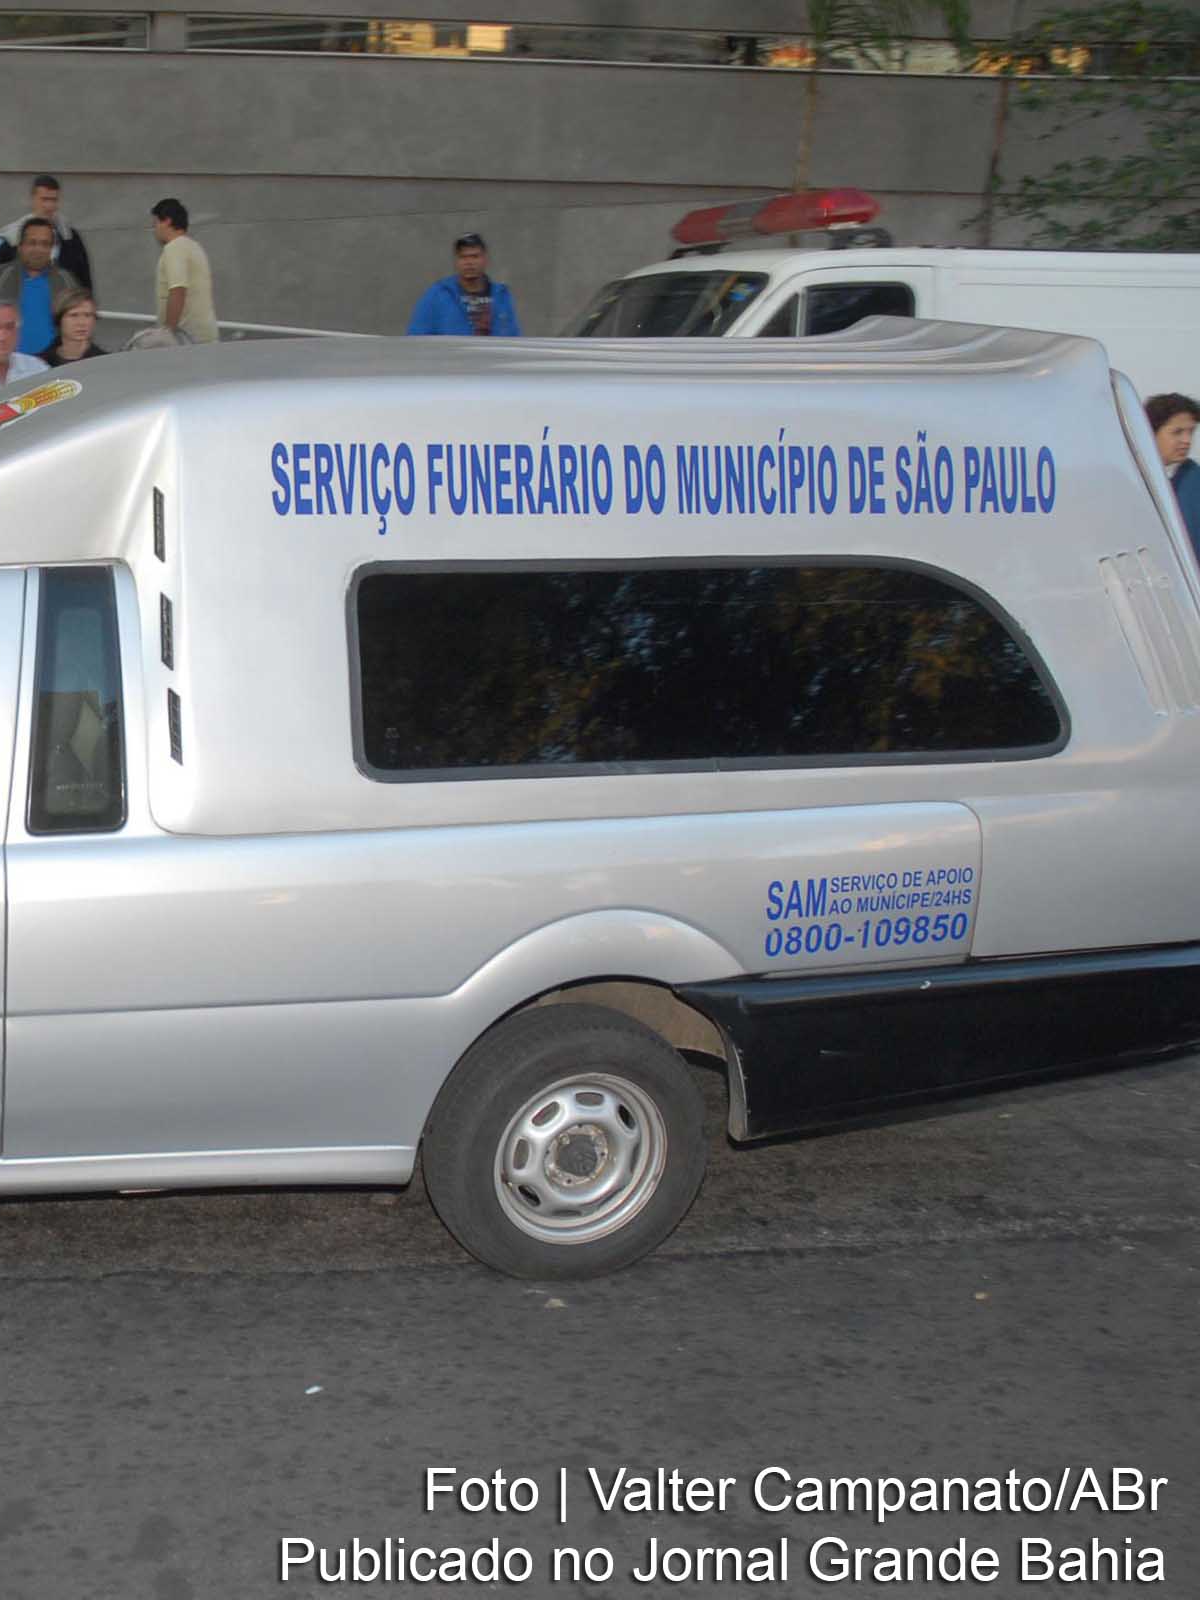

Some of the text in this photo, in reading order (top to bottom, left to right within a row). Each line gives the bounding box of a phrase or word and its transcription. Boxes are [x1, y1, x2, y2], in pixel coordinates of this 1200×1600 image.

[271, 426, 1056, 536] SERVIÇO FUNERÁRIO DO MUNICÍPIO DE SÃO PAULO
[766, 878, 827, 921] SAM
[830, 867, 973, 893] SERVIÇO DE APOIO
[828, 898, 852, 915] AO
[764, 912, 968, 957] 0800-109850
